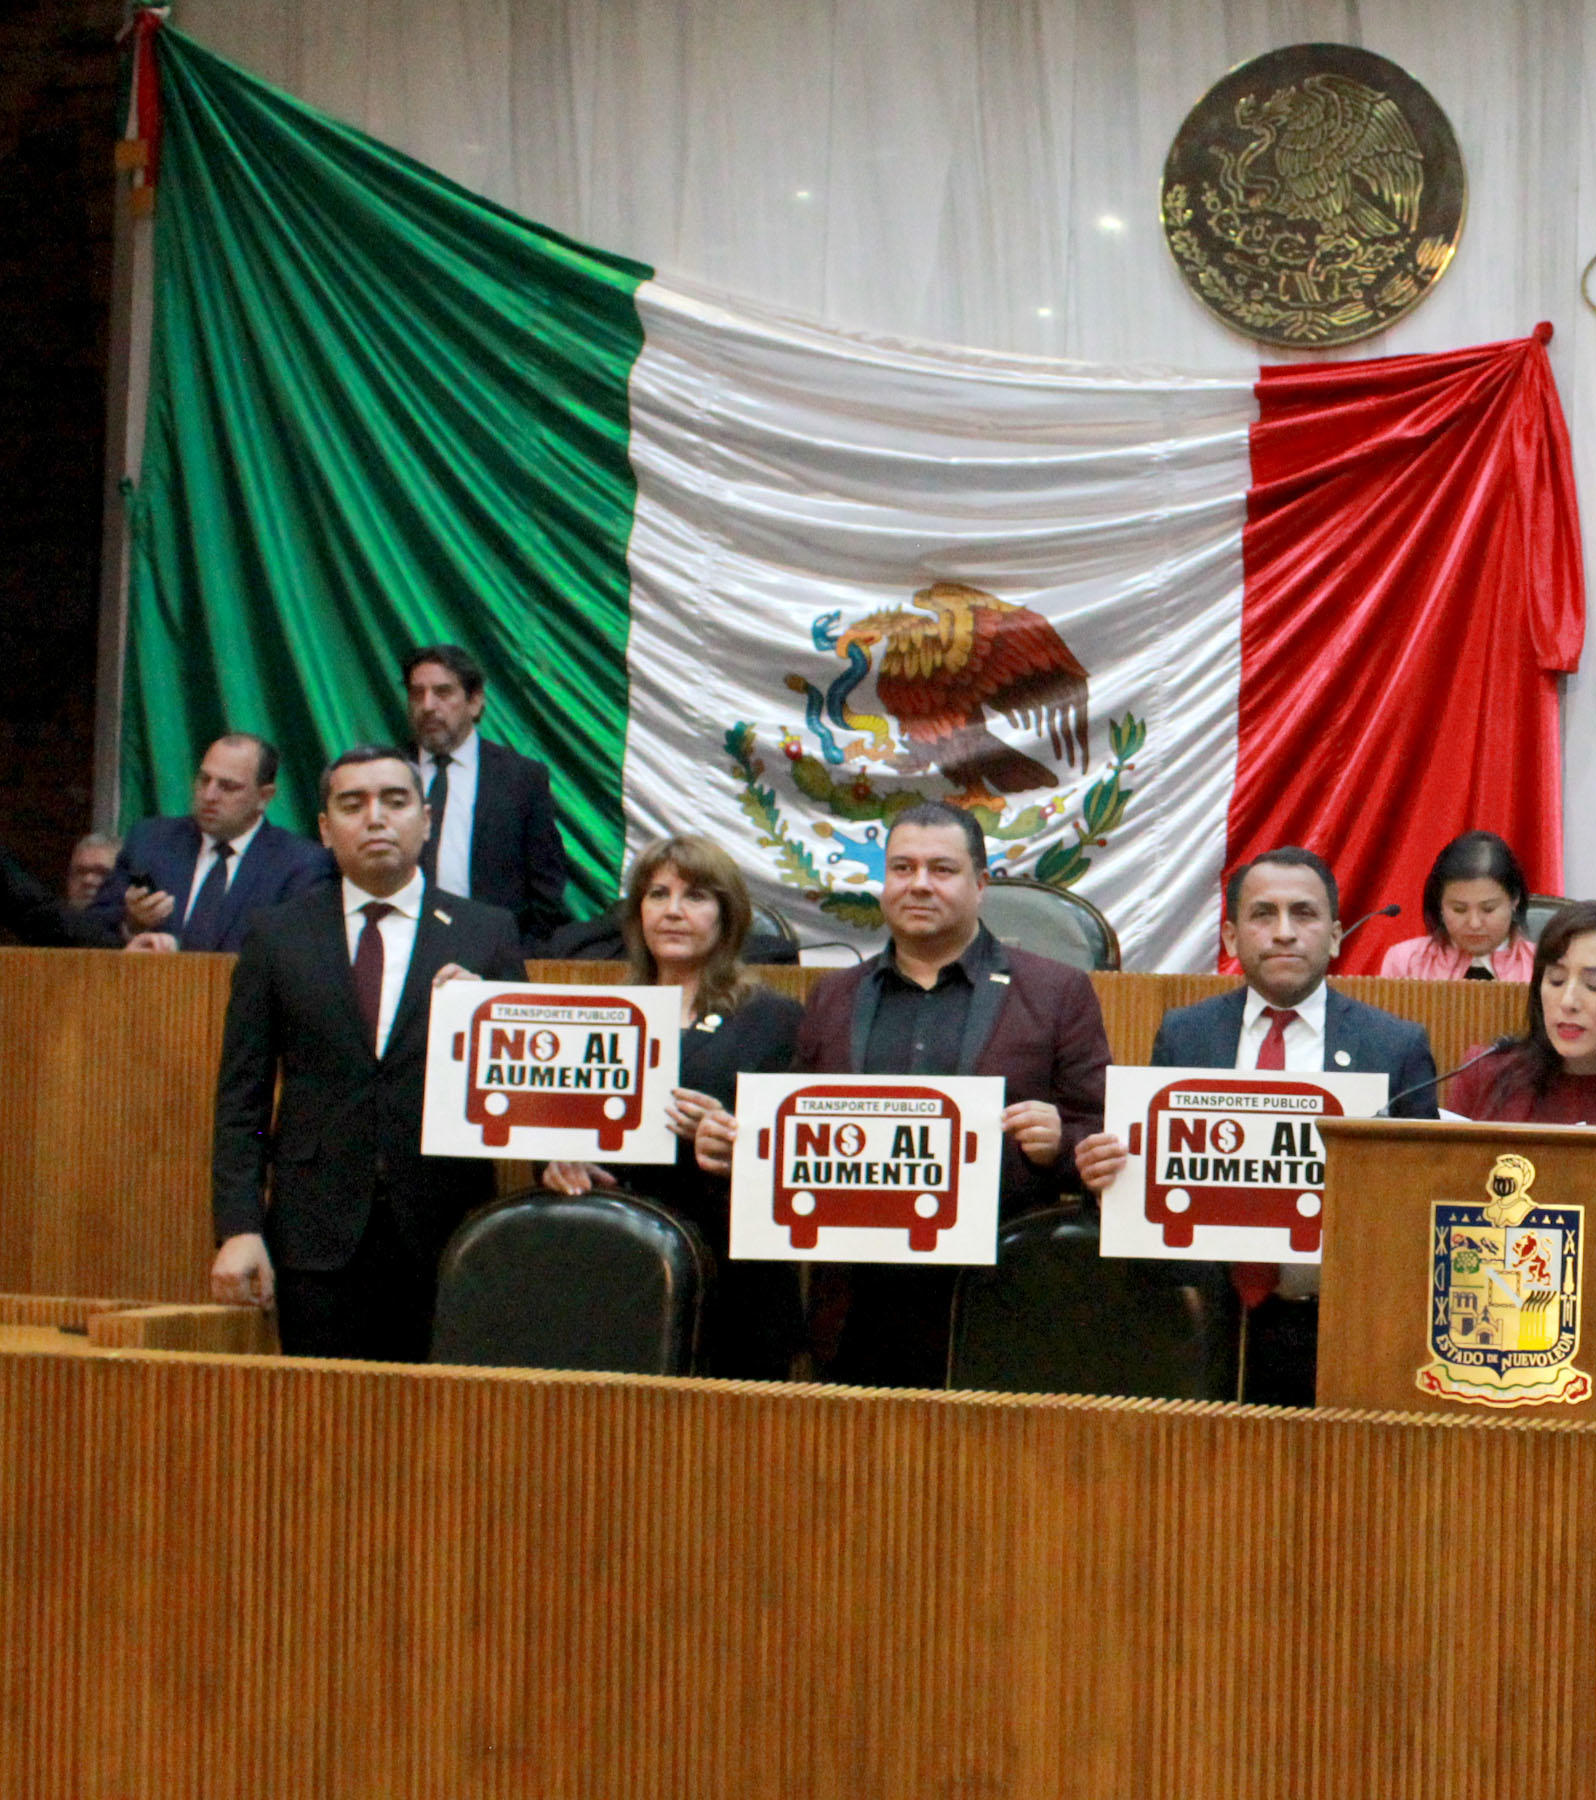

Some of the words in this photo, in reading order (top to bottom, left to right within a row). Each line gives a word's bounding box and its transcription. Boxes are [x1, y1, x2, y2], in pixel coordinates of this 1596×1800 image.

[497, 1007, 573, 1020] TRANSPORTE
[577, 1010, 626, 1021] PUBLICO
[583, 1032, 622, 1064] AL
[485, 1064, 629, 1090] AUMENTO
[802, 1100, 880, 1112] TRANSPORTE
[884, 1102, 936, 1113] PUBLICO
[1175, 1094, 1259, 1108] TRANSPORTE
[1263, 1097, 1318, 1110] PUBLICO
[891, 1125, 934, 1159] AL
[1271, 1121, 1317, 1157] AL
[792, 1161, 943, 1186] AUMENTO
[1165, 1157, 1325, 1185] AUMENTO
[1436, 1334, 1484, 1366] ESTADO
[1487, 1354, 1499, 1364] DE
[1501, 1352, 1547, 1372] NUEVO
